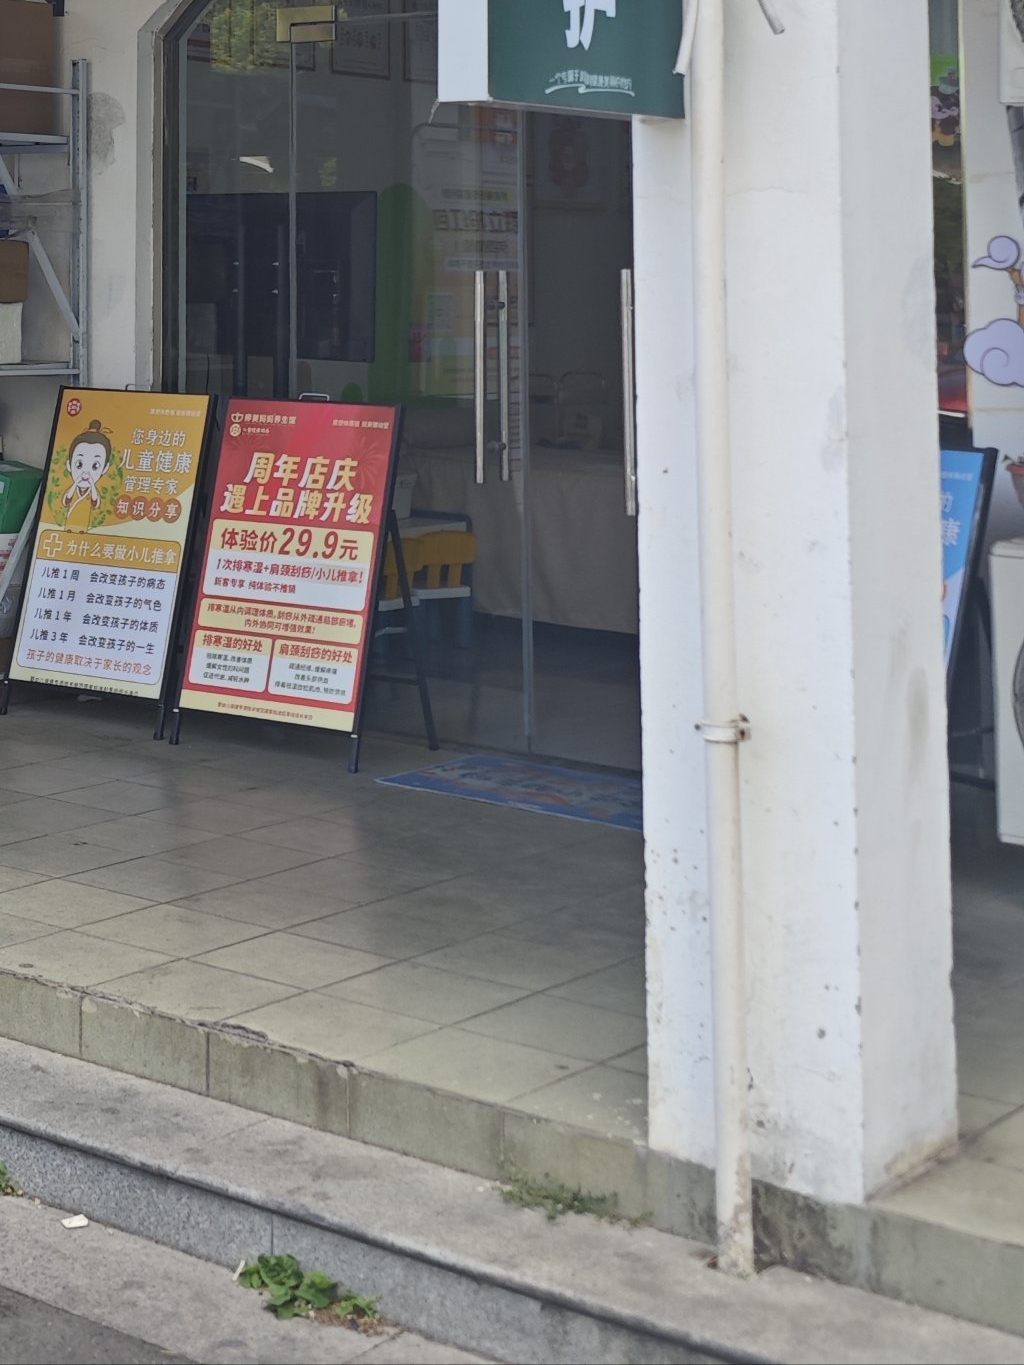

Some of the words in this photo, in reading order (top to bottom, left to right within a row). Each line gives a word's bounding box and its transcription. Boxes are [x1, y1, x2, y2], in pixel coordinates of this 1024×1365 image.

[131, 427, 186, 447] 您身边的
[119, 448, 193, 475] 儿童健康
[244, 451, 359, 492] 周年店庆
[124, 475, 178, 495] 管理专家
[116, 498, 179, 519] 知识分享
[219, 483, 374, 525] 遇上品牌升级
[66, 540, 177, 566] 为什么要做小儿推拿
[220, 527, 359, 561] 体验价29.9元
[89, 571, 166, 590] 会改变孩子的病态
[214, 576, 246, 589] 新客专享
[85, 592, 163, 612] 会改变孩子的气色
[81, 613, 159, 633] 会改变孩子的体质
[78, 634, 155, 655] 会改变孩子的一生
[202, 634, 263, 653] 排寒湿的好处
[278, 643, 353, 664] 肩颈刮痧的好处
[26, 648, 153, 676] 孩子的健康取决于家长的观念
